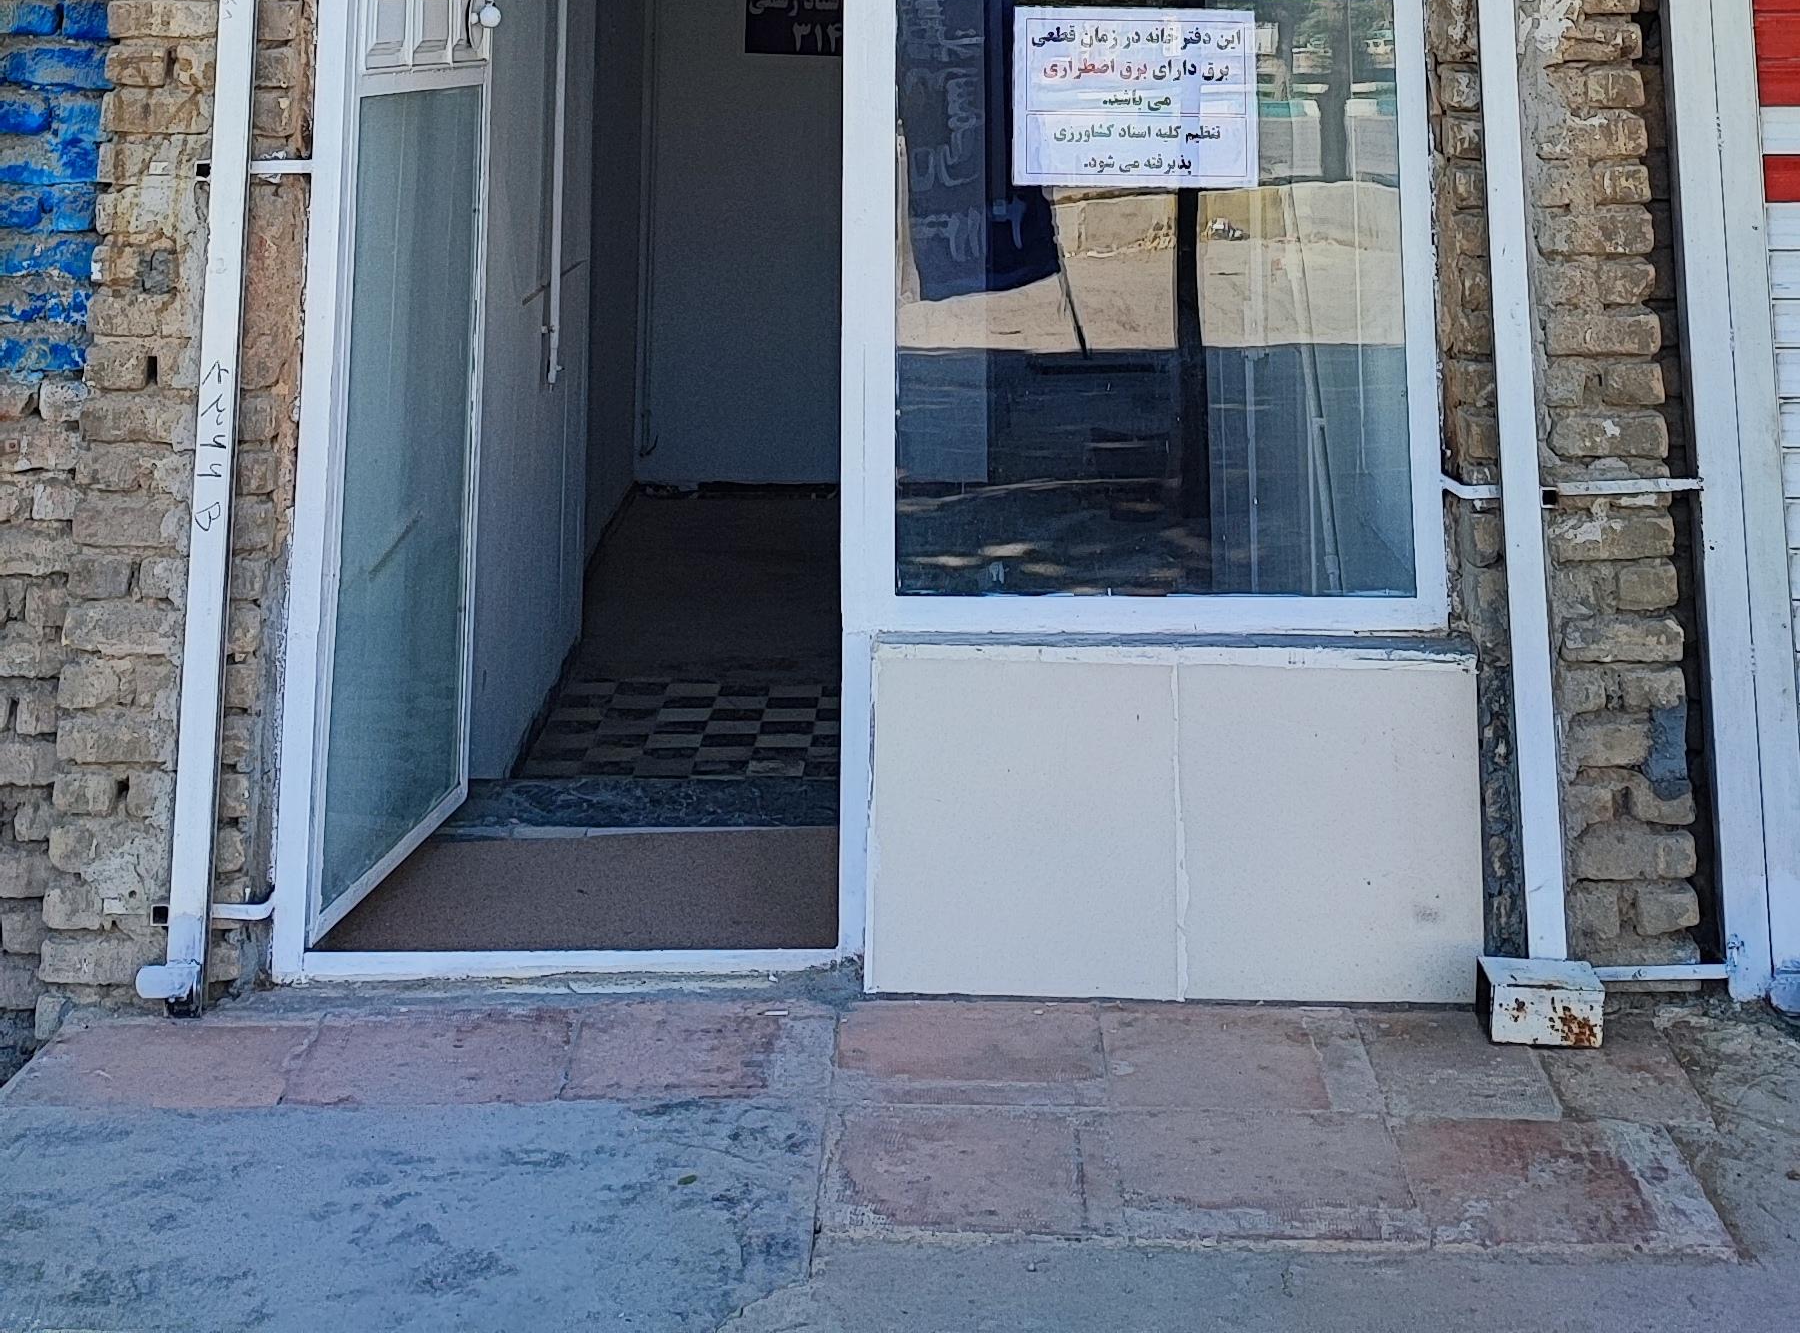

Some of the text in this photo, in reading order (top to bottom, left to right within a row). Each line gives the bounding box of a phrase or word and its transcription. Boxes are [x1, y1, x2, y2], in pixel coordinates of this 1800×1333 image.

[792, 21, 842, 52] ۳۱۴
[1031, 25, 1076, 47] قطعی
[1081, 25, 1118, 50] زمان
[1122, 31, 1141, 49] در
[1216, 28, 1241, 51] این
[1043, 58, 1230, 82] برق دارای برق اضطراری
[1147, 96, 1172, 112] می
[1053, 123, 1221, 144] تنظیم کلیه اسناد کشاورزی
